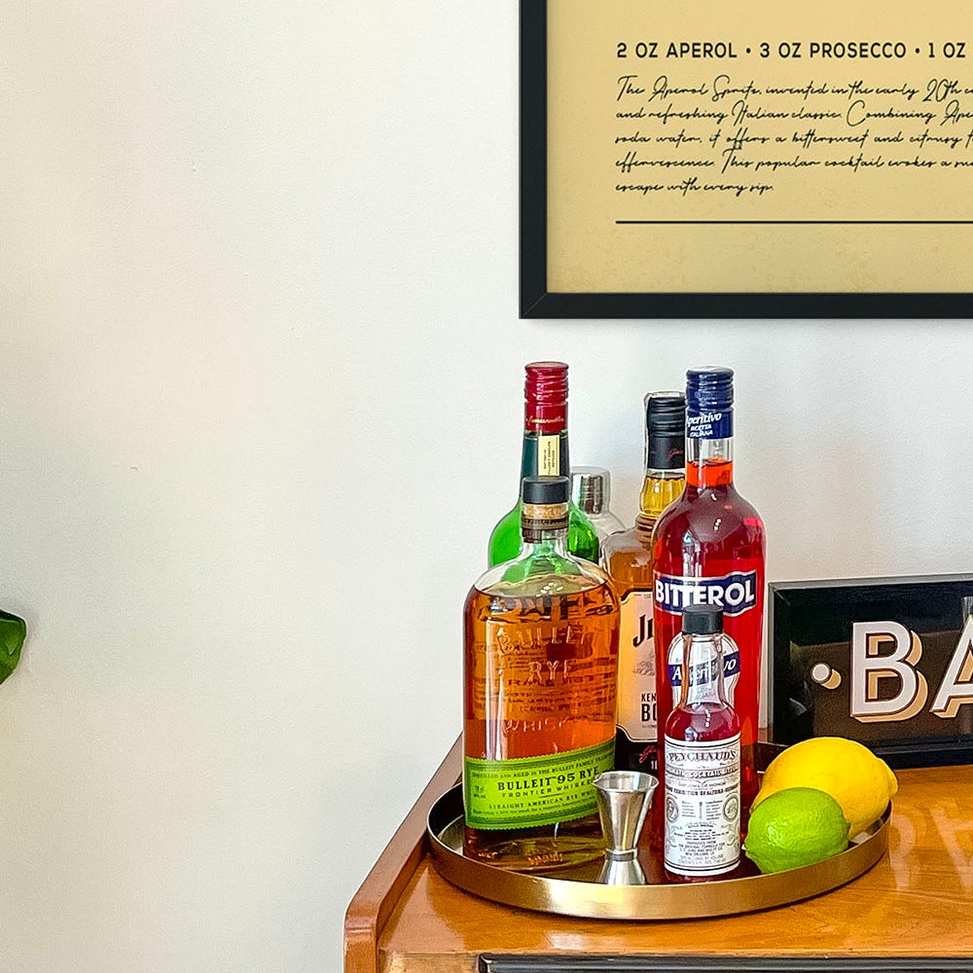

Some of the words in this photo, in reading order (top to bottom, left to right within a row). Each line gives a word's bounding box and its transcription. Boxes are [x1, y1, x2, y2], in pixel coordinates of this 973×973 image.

[616, 42, 627, 59] 2
[635, 42, 659, 59] OZ
[665, 42, 738, 59] APEROL
[759, 42, 770, 59] 3
[778, 42, 802, 59] OZ
[809, 42, 907, 59] PROSECCO
[928, 42, 936, 59] 1
[942, 42, 966, 59] OZ
[617, 75, 646, 102] The
[648, 75, 709, 102] Aperol
[765, 80, 830, 100] invented
[831, 85, 848, 95] in
[848, 80, 874, 100] the
[875, 83, 920, 101] early
[922, 78, 963, 102] 20th
[615, 107, 647, 118] and
[648, 103, 729, 125] refreshing
[731, 99, 790, 126] Italian
[846, 99, 937, 127] Combining
[614, 131, 652, 144] soda
[708, 129, 722, 148] it
[725, 127, 771, 149] offers
[791, 129, 870, 148] bittersweet
[873, 131, 905, 143] and
[909, 129, 963, 149] citrusy
[721, 147, 754, 174] This
[755, 155, 821, 171] popular
[824, 153, 885, 172] cocktail
[888, 156, 937, 168] evokes
[615, 183, 665, 196] escape
[666, 177, 702, 196] with
[703, 183, 748, 197] every
[655, 579, 755, 608] BITTEROL
[498, 777, 551, 791] BULLEIT
[557, 772, 576, 784] 95
[579, 765, 599, 780] RYE
[502, 788, 553, 798] FRONTIER
[556, 779, 593, 792] WHISKE
